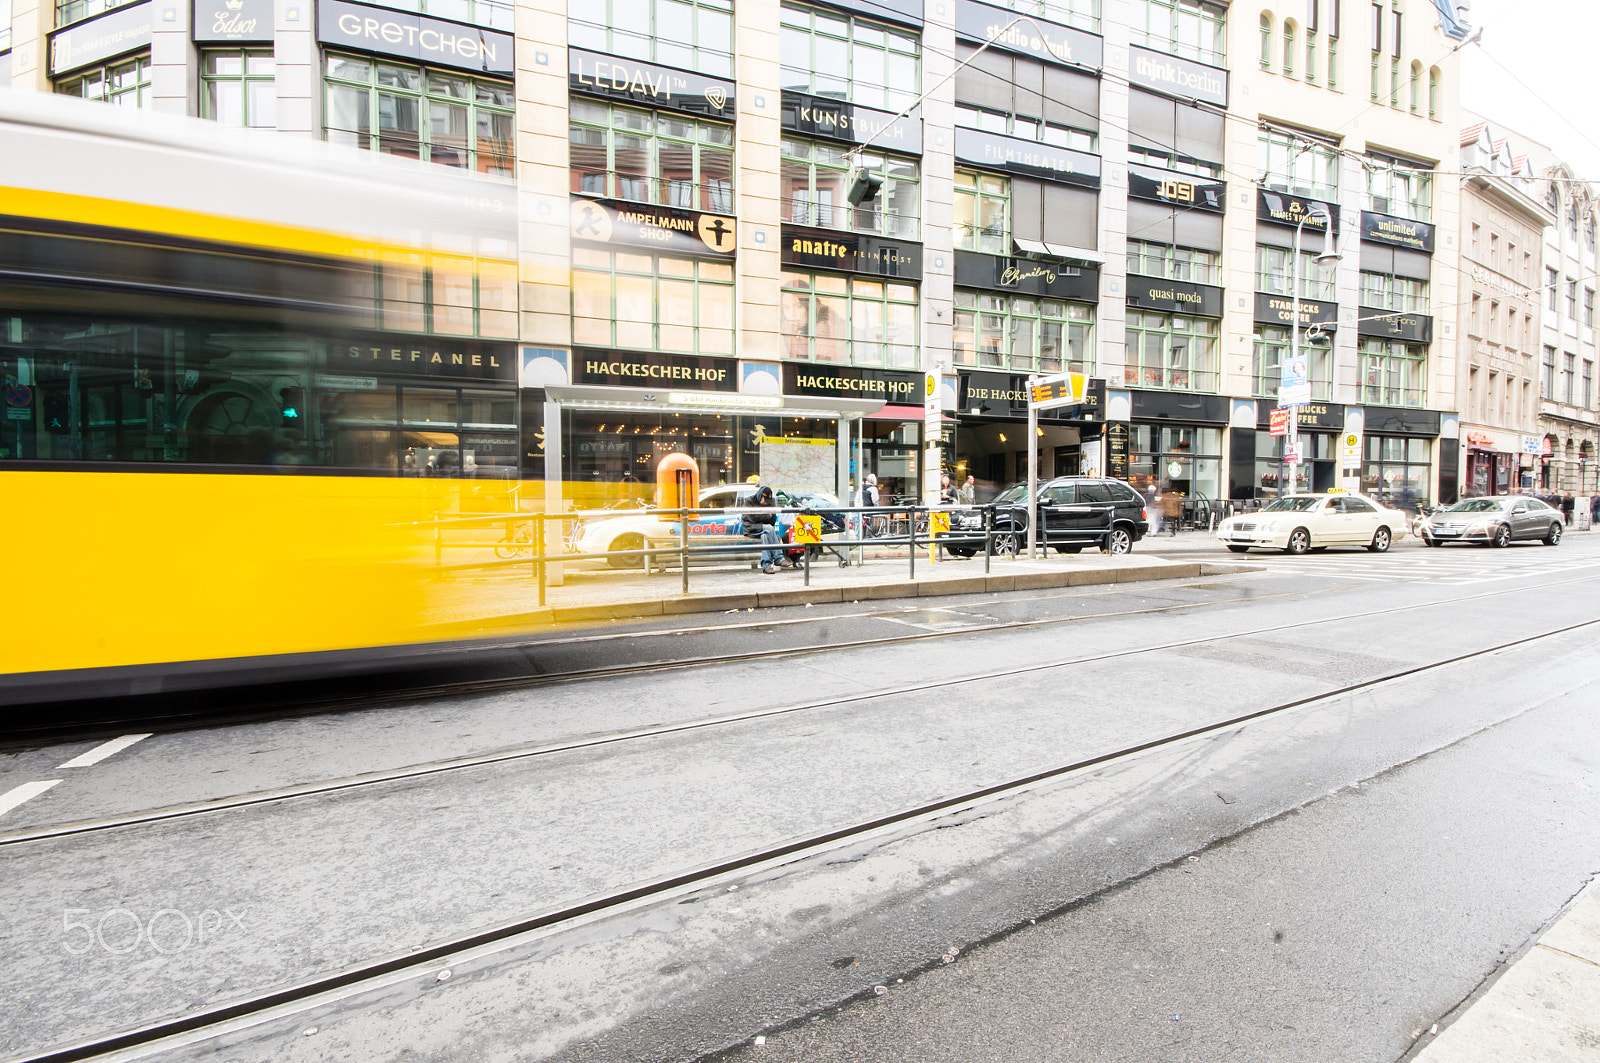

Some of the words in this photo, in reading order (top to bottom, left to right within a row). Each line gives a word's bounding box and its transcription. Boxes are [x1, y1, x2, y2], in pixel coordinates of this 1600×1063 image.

[212, 11, 256, 33] Edsor
[1177, 66, 1221, 94] berlin
[985, 144, 1074, 173] FILMTHEATER
[617, 211, 694, 232] AMPELMANN
[1378, 219, 1416, 237] unlimited
[639, 228, 674, 241] SHOP
[792, 239, 847, 259] anatre
[854, 250, 911, 264] FEINKOST
[1149, 288, 1174, 301] quasi
[1176, 291, 1202, 304] moda
[1278, 310, 1311, 323] COFEE
[349, 346, 500, 368] STEFANEL
[586, 360, 692, 380] HACKESCHER
[695, 368, 727, 382] HOF
[796, 374, 886, 393] HACKESCHER
[888, 381, 915, 395] HOF
[967, 387, 989, 399] DIE
